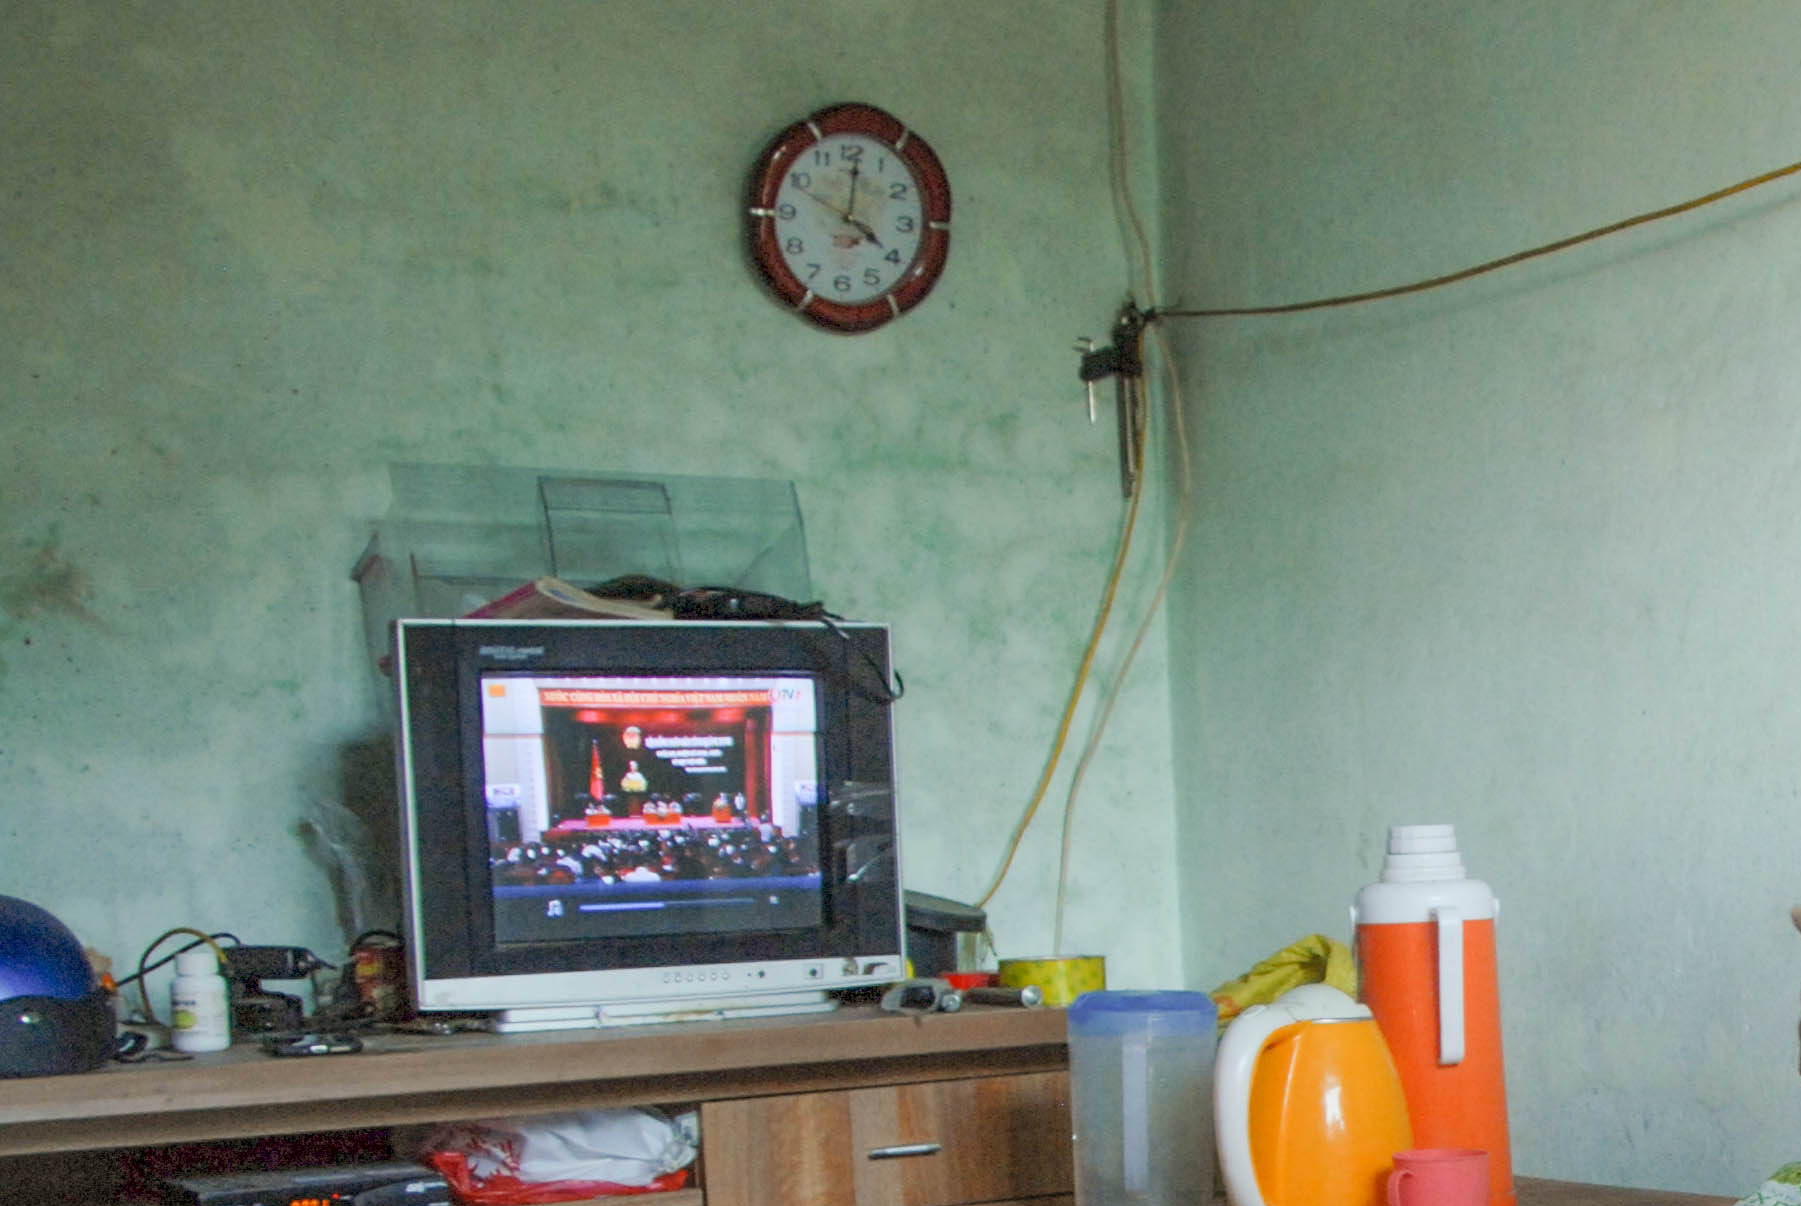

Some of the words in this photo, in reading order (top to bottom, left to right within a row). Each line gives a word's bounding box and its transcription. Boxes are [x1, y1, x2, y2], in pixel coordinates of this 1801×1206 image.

[814, 150, 830, 167] 11
[840, 144, 863, 162] 12
[878, 157, 885, 173] 1
[790, 172, 812, 189] 10
[889, 183, 907, 200] 2
[779, 204, 797, 220] 9
[896, 215, 914, 233] 3
[786, 237, 803, 254] 8
[884, 248, 900, 264] 4
[806, 263, 821, 280] 7
[863, 268, 881, 286] 5
[833, 275, 851, 292] 6
